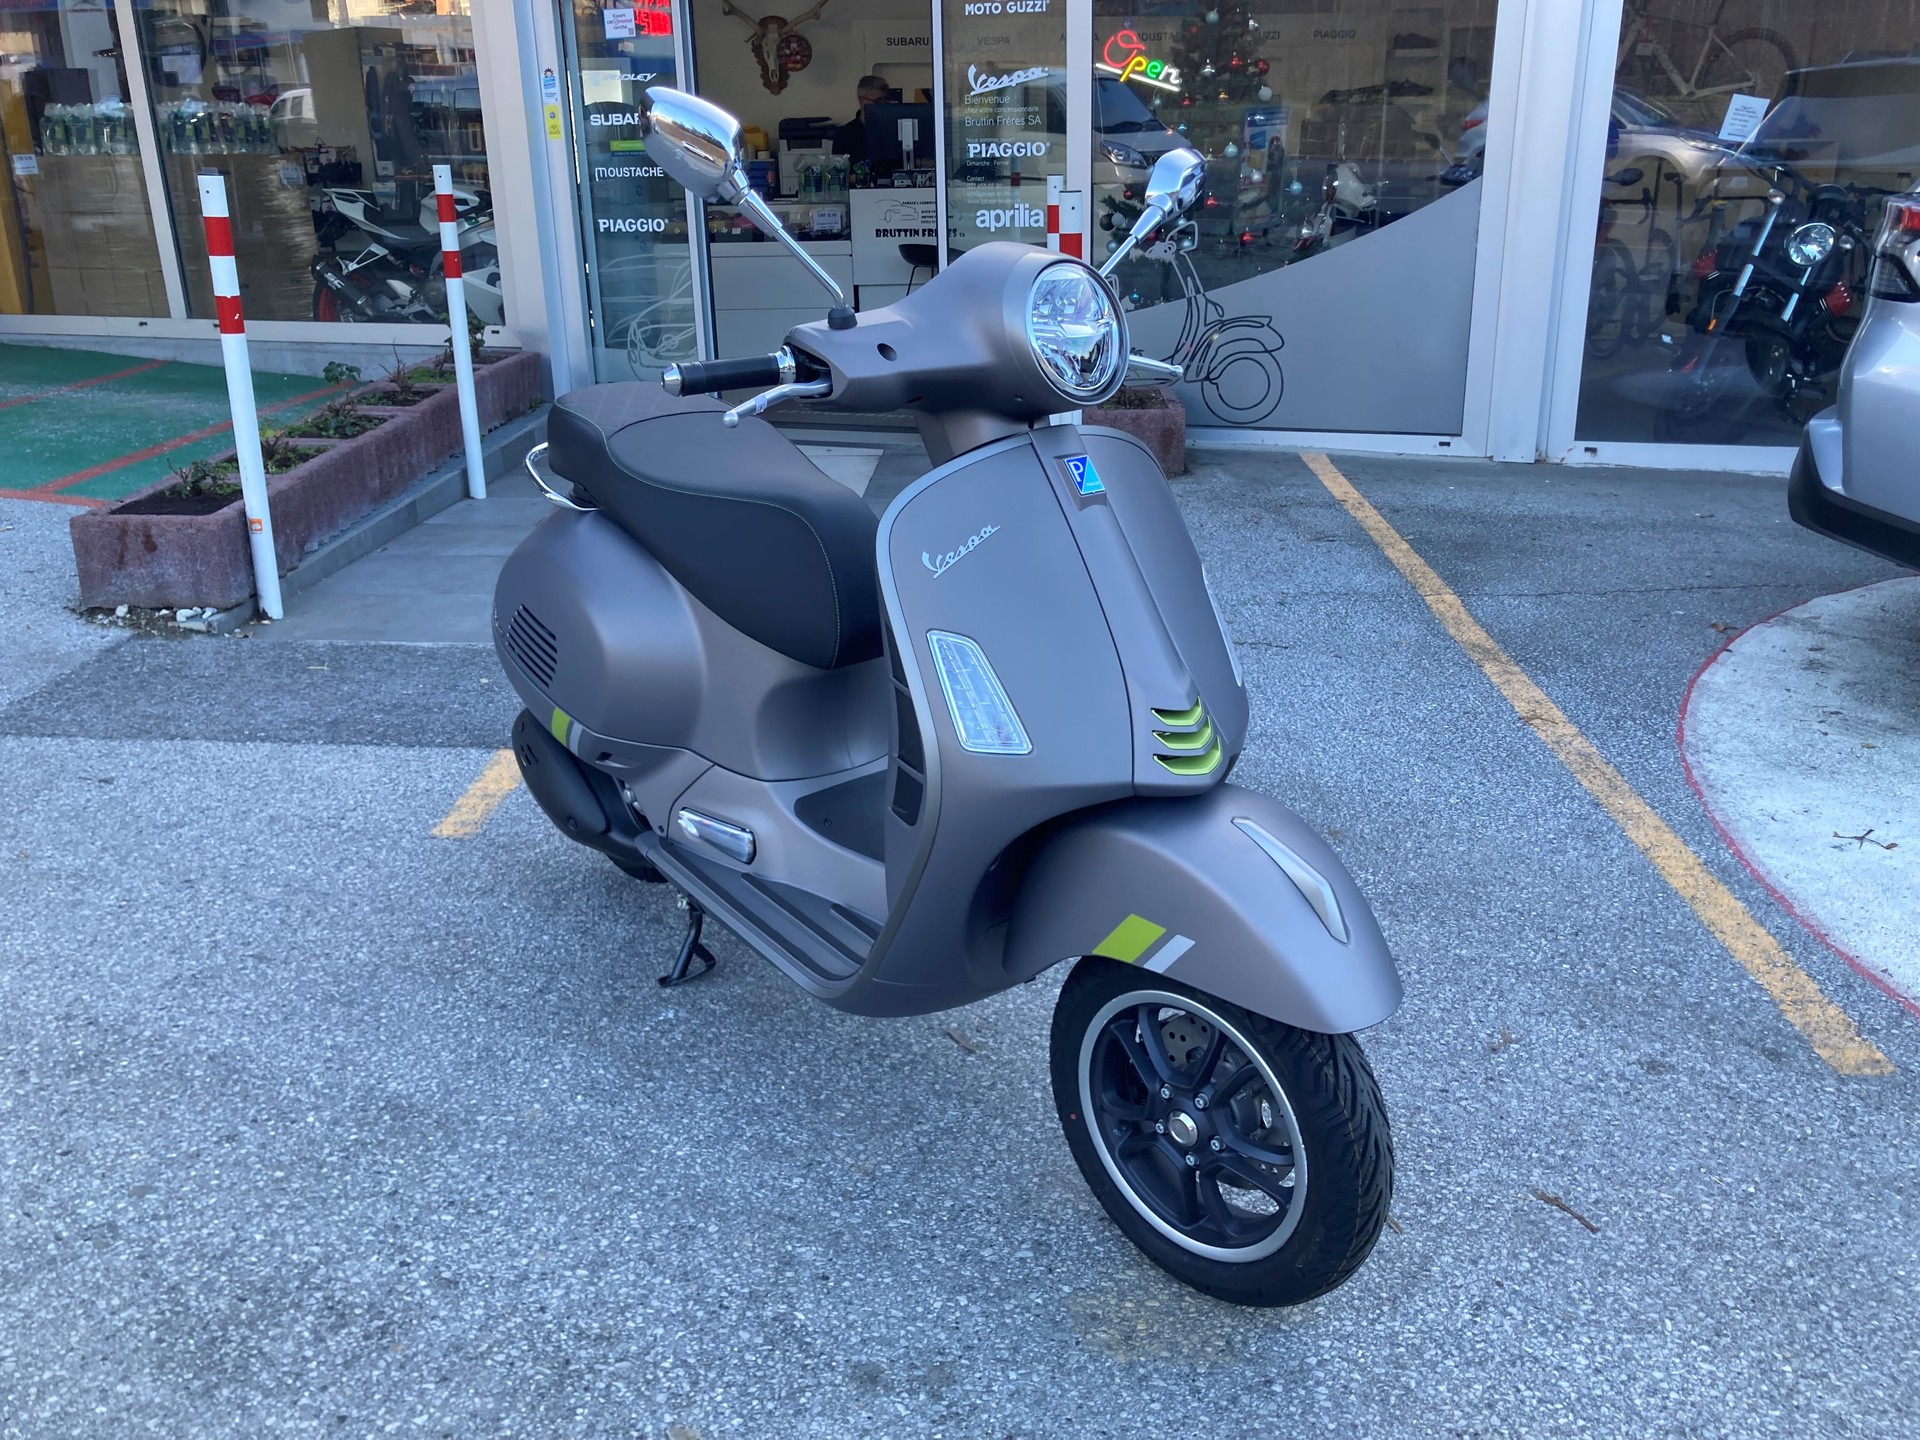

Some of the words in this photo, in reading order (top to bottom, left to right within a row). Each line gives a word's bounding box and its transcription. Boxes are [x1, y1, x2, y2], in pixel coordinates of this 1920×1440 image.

[965, 0, 1002, 16] MOTO
[1006, 0, 1047, 14] GUZZI
[886, 36, 930, 47] SUBARU
[976, 35, 1010, 46] VESPA
[1313, 30, 1356, 40] PIAGGIO
[1103, 29, 1181, 84] Open
[967, 63, 1049, 96] Vespa
[964, 94, 1010, 105] Bienvenue
[589, 113, 640, 126] SUBAR
[965, 116, 995, 127] Bruttin
[996, 115, 1025, 126] Frères
[1027, 114, 1042, 125] SA
[967, 141, 1046, 158] PIAGGIO
[595, 166, 664, 182] MOUSTACHE
[975, 203, 1044, 232] aprilia
[597, 218, 666, 233] PIAGGIO
[875, 228, 920, 238] BRUTTIN
[1068, 460, 1085, 483] P
[921, 524, 1001, 580] Vespa
